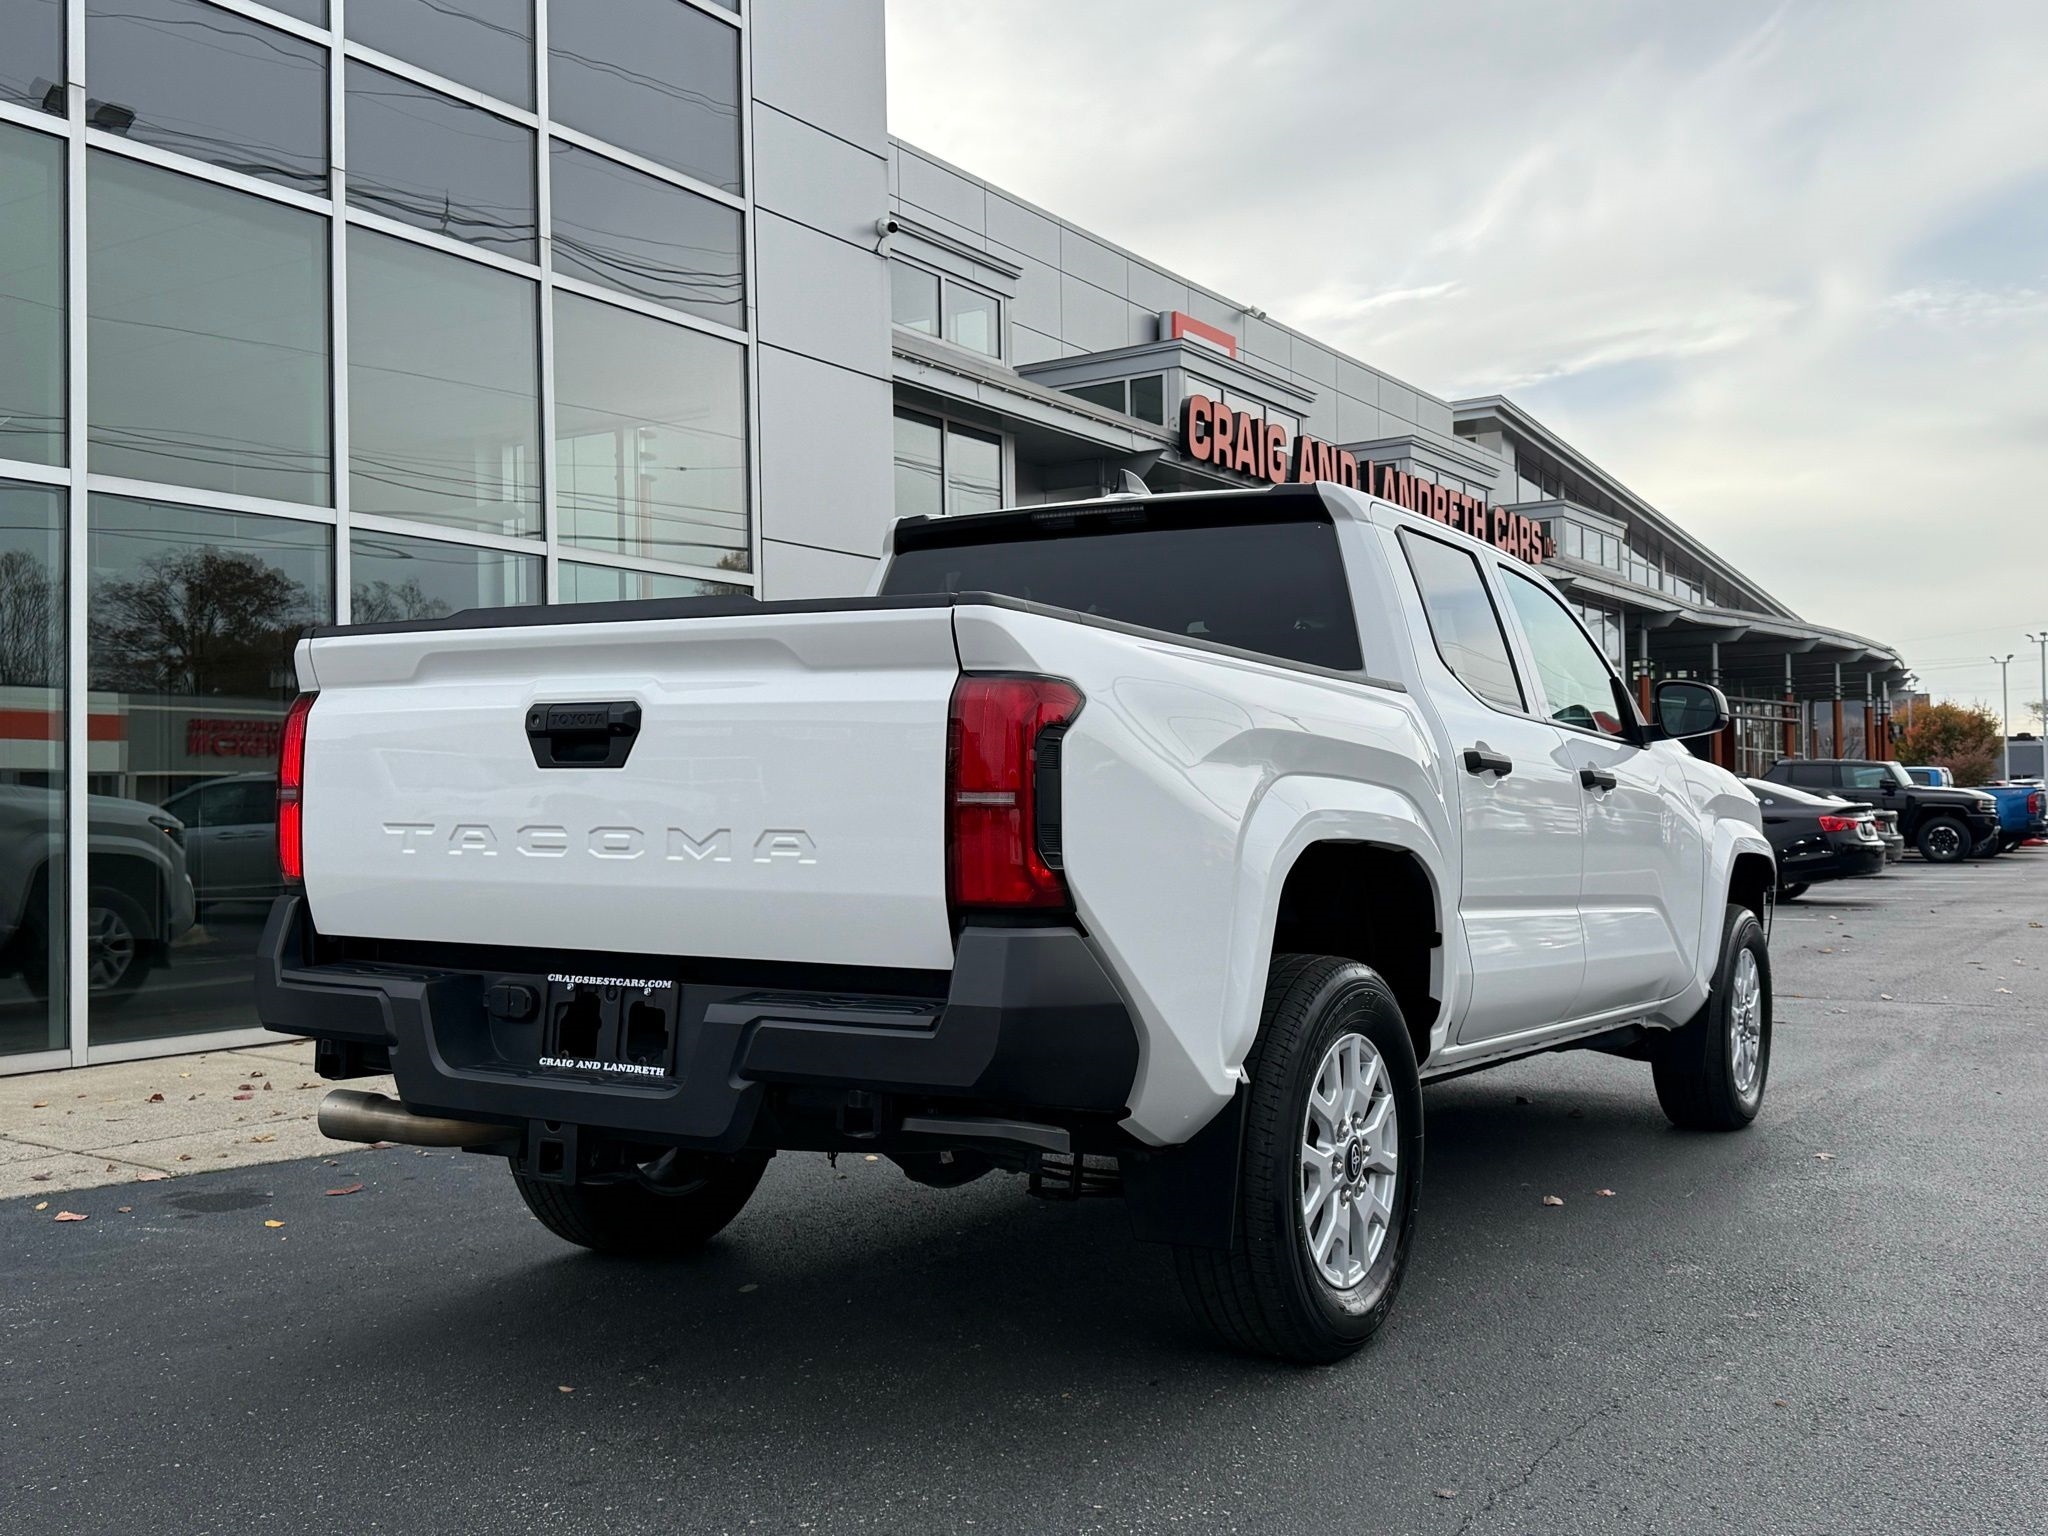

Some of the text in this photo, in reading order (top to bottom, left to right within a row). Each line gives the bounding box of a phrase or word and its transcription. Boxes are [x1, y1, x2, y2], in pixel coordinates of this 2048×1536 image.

[1186, 394, 1288, 485] CRAIG
[1298, 434, 1358, 489] AND
[1493, 506, 1543, 565] CARS
[551, 713, 604, 726] TOYOTA
[382, 822, 818, 864] TACOMA
[547, 973, 672, 989] CRAIGSBESTCARS.COM
[539, 1057, 665, 1076] CRAIG AND LANDRETH
